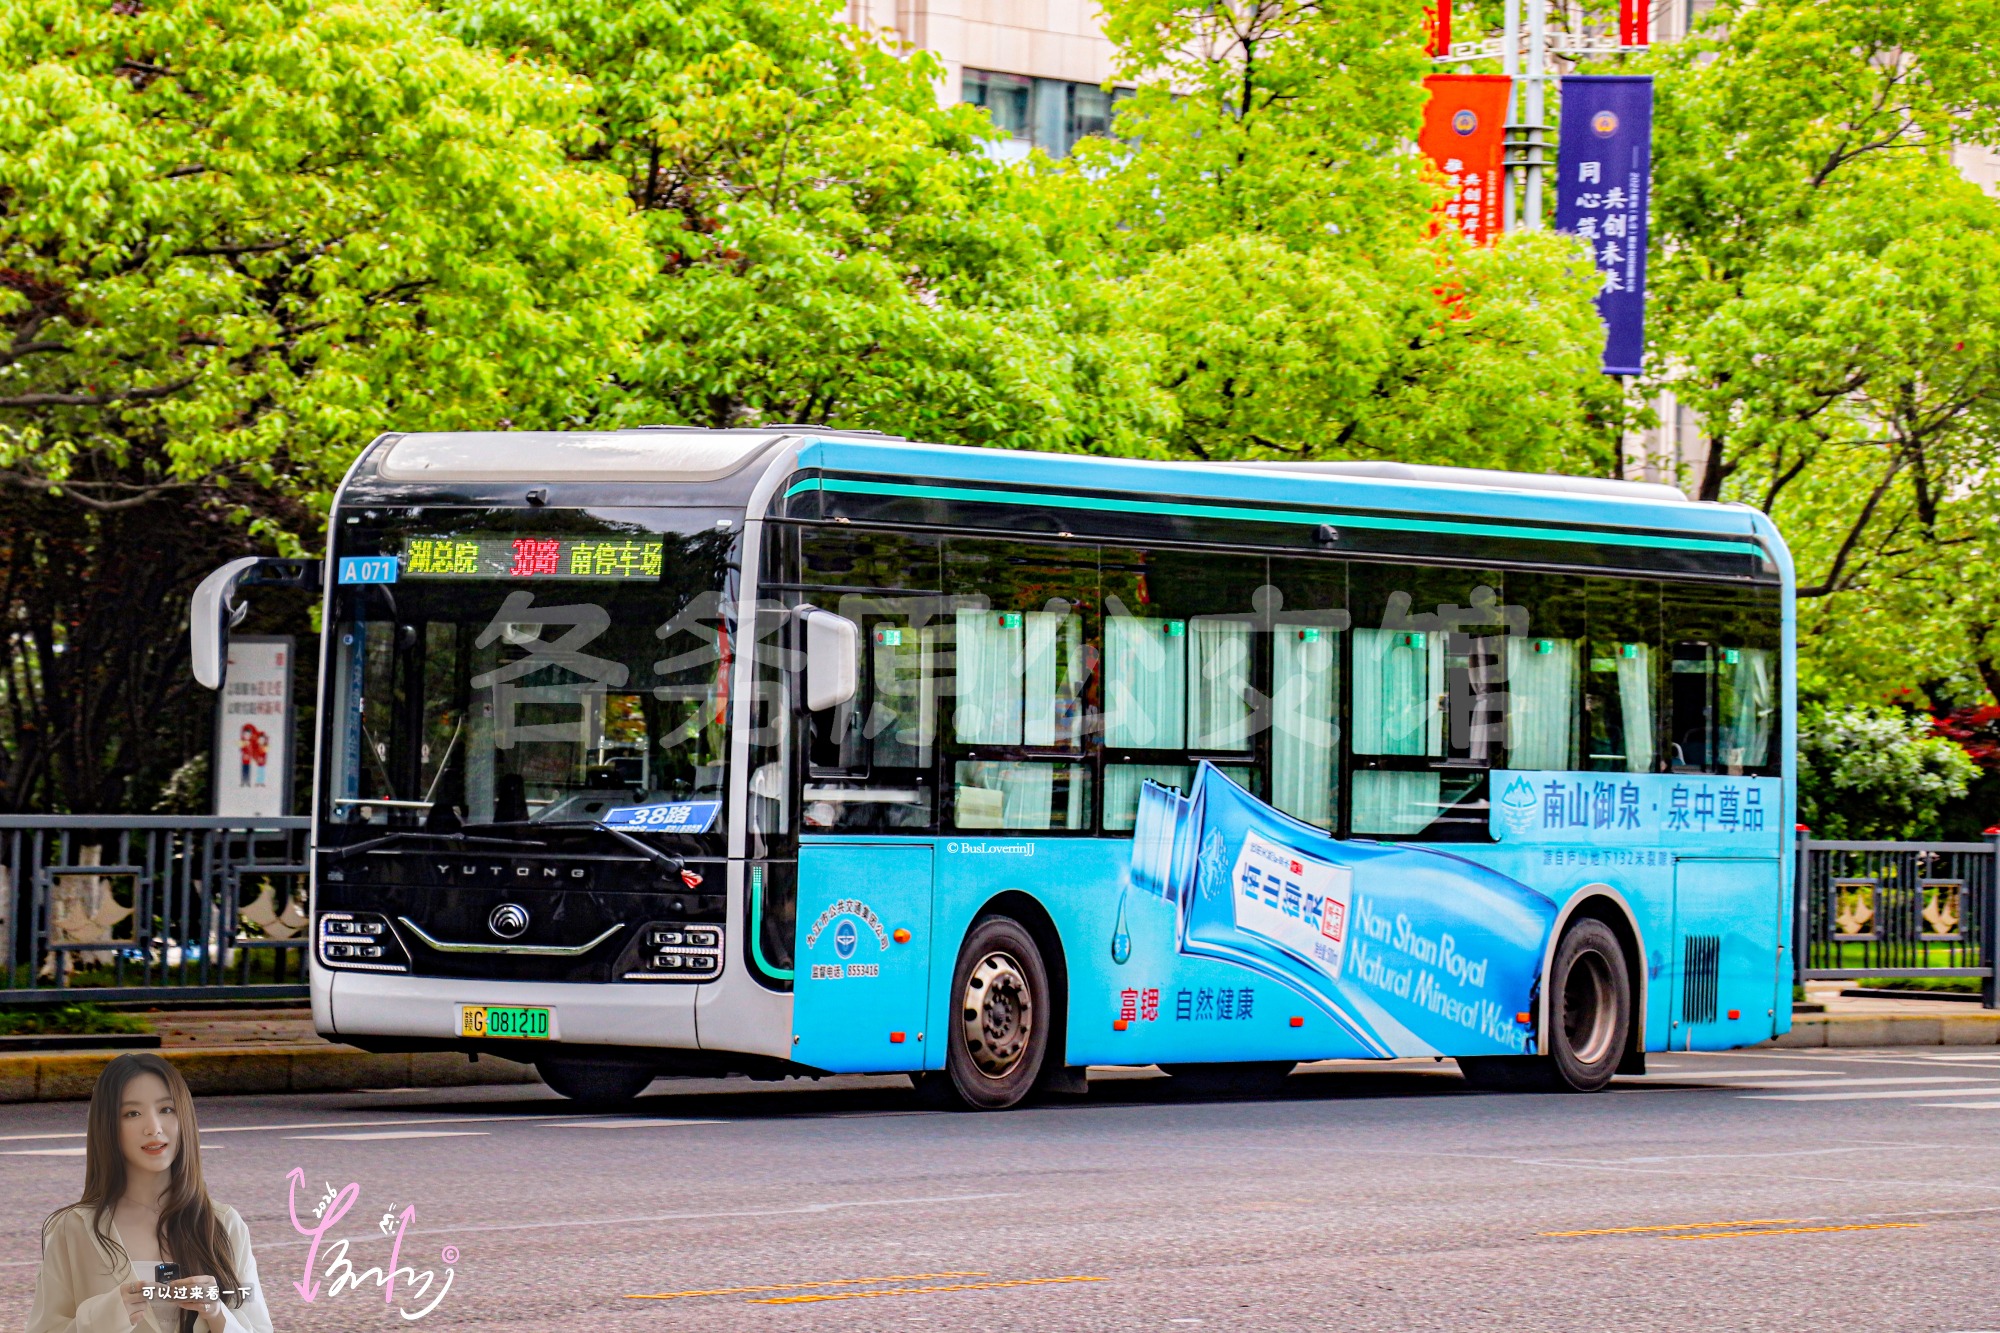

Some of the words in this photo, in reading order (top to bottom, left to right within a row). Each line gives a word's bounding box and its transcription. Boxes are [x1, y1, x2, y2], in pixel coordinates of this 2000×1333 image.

[1601, 187, 1628, 294] 共创未来
[345, 562, 357, 580] A
[362, 562, 389, 580] 071
[571, 541, 663, 576] 南停车场
[628, 806, 692, 825] 38路
[438, 865, 584, 878] YUTONG
[1242, 862, 1324, 931] 南山御泉
[1355, 894, 1392, 944] Nan
[1393, 913, 1437, 966] Shan
[1438, 933, 1488, 987] Royal
[848, 964, 879, 977] 8553416
[1120, 987, 1159, 1021] 富锶
[1176, 986, 1255, 1021] 自然健康
[1348, 937, 1412, 999] Natural
[1412, 969, 1480, 1030] Mineral
[1481, 998, 1530, 1052] Water
